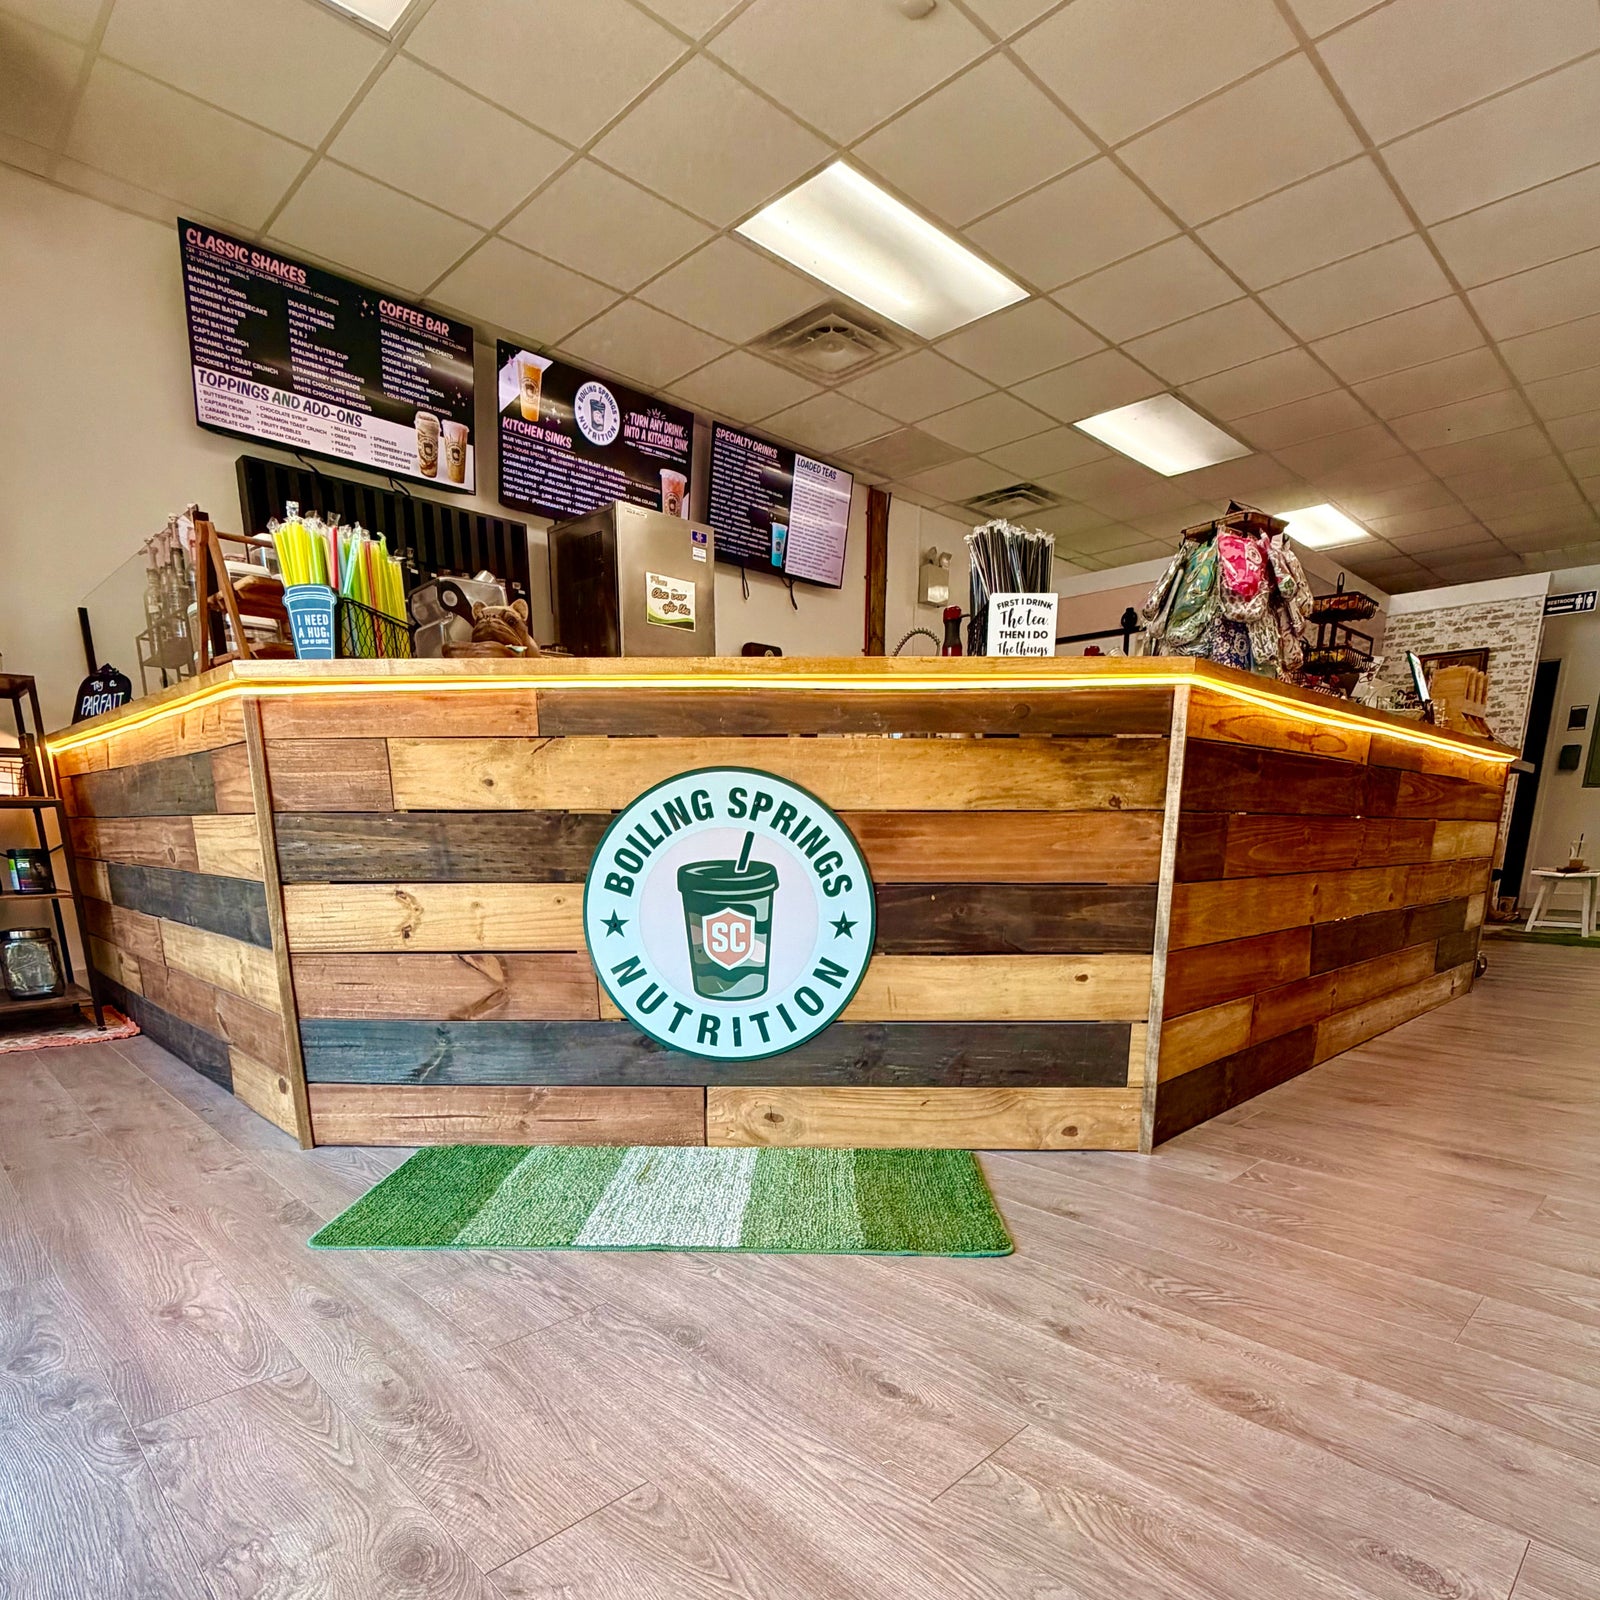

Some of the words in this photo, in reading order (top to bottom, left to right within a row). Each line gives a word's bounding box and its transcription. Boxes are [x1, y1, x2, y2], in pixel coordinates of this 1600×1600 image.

[186, 227, 250, 265] CLASSIC
[250, 251, 307, 286] SHAKES
[187, 264, 216, 280] BANANA
[216, 274, 230, 285] NUT
[188, 275, 217, 290] BANANA
[217, 285, 247, 301] PUDDING
[189, 285, 227, 303] BLUEBERRY
[228, 298, 268, 317] CHEESECAKE
[190, 295, 221, 311] BROWNIE
[222, 305, 246, 319] BATTER
[288, 299, 307, 312] DULCE
[308, 306, 317, 315] DE
[317, 310, 335, 322] LECHE
[191, 305, 239, 326] BUTTERFINGER
[192, 315, 210, 327] CAKE
[210, 321, 236, 335] BATTER
[288, 309, 310, 321] FRUITY
[310, 317, 335, 330] PEBBLES
[289, 318, 317, 334] FUNFETTI
[379, 298, 425, 329] COFFEE
[425, 316, 450, 338] BAR
[193, 325, 222, 340] CAPTAIN
[222, 334, 250, 349] CRUNCH
[290, 328, 298, 336] PB
[381, 329, 400, 342] SALTED
[400, 336, 424, 350] CARAMEL
[193, 335, 224, 350] CARAMEL
[225, 345, 243, 356] CAKE
[290, 337, 314, 350] PEANUT
[314, 345, 336, 358] BUTTER
[336, 352, 349, 362] CUP
[381, 338, 406, 352] CARAMEL
[406, 347, 426, 359] MOCHA
[194, 345, 231, 361] CINNAMON
[231, 356, 252, 368] TOAST
[252, 362, 279, 376] CRUNCH
[195, 355, 225, 369] COOKIES
[225, 363, 230, 371] &
[230, 365, 253, 377] CREAM
[291, 347, 319, 361] PRALINES
[324, 357, 344, 369] CREAM
[381, 347, 413, 363] CHOCOLATE
[413, 358, 432, 370] MOCHA
[382, 356, 402, 368] COOKIE
[402, 363, 417, 373] LATTE
[291, 356, 330, 373] STRAWBERRY
[330, 368, 365, 385] CHEESECAKE
[292, 365, 330, 382] STRAWBERRY
[330, 377, 361, 392] LEMONADE
[382, 365, 407, 378] PRALINES
[412, 374, 430, 386] CREAM
[293, 374, 311, 385] WHITE
[312, 380, 345, 396] CHOCOLATE
[383, 373, 402, 385] SALTED
[402, 380, 425, 393] CARAMEL
[426, 387, 445, 399] MOCHA
[383, 382, 399, 393] WHITE
[400, 388, 430, 402] CHOCOLATE
[198, 369, 270, 402] TOPPINGS
[271, 390, 301, 411] AND
[302, 398, 363, 428] ADD-ONS
[203, 390, 244, 406] BUTTERFINGER
[204, 398, 228, 409] CAPTAIN
[229, 405, 252, 416] CRUNCH
[293, 384, 312, 395] WHITE
[312, 389, 346, 404] CHOCOLATE
[346, 399, 373, 413] SNICKERS
[578, 385, 596, 403] BOILING
[598, 387, 617, 414] SPRINGS
[204, 406, 231, 418] CARAMEL
[232, 413, 250, 423] SYRUP
[205, 414, 238, 427] CHOCOLATE
[239, 422, 256, 432] CHIPS
[260, 405, 291, 419] CHOCOLATE
[291, 414, 309, 423] SYRUP
[260, 413, 289, 426] CINNAMON
[290, 421, 306, 430] TOAST
[306, 425, 328, 436] CRUNCH
[630, 411, 649, 430] TURN
[650, 417, 664, 434] ANY
[664, 420, 684, 439] DRINK
[261, 421, 279, 430] FRUITY
[280, 426, 302, 436] PEBBLES
[262, 429, 284, 439] GRAHAM
[285, 435, 311, 446] CRACKERS
[348, 430, 367, 440] WAFERS
[503, 416, 543, 441] KITCHEN
[545, 430, 573, 449] SINKS
[579, 416, 616, 441] NUTRITION
[624, 424, 640, 441] INTO
[641, 428, 646, 442] A
[648, 430, 674, 449] KITCHEN
[674, 437, 689, 453] SINK
[373, 437, 397, 447] SPRINKLES
[374, 444, 403, 456] STRAWBERRY
[403, 451, 418, 460] SYRUP
[716, 427, 753, 451] SPECIALTY
[753, 441, 778, 460] DRINKS
[374, 458, 394, 467] WHIPPED
[395, 463, 411, 471] CREAM
[797, 457, 822, 475] LOADED
[822, 467, 837, 481] TEAS
[997, 599, 1019, 610] FIRST
[1027, 598, 1053, 610] DRINK
[297, 615, 301, 625] I
[304, 615, 329, 625] NEED
[1000, 608, 1024, 628] The
[299, 627, 304, 638] A
[1028, 631, 1030, 639] I
[1033, 631, 1048, 639] DO
[997, 641, 1014, 655] The
[1016, 641, 1049, 656] things
[81, 692, 124, 716] PARFAIT
[604, 789, 714, 897] BOILING
[728, 787, 852, 897] SPRINGS
[711, 922, 746, 952] SC
[610, 955, 849, 1047] NUTRITION
